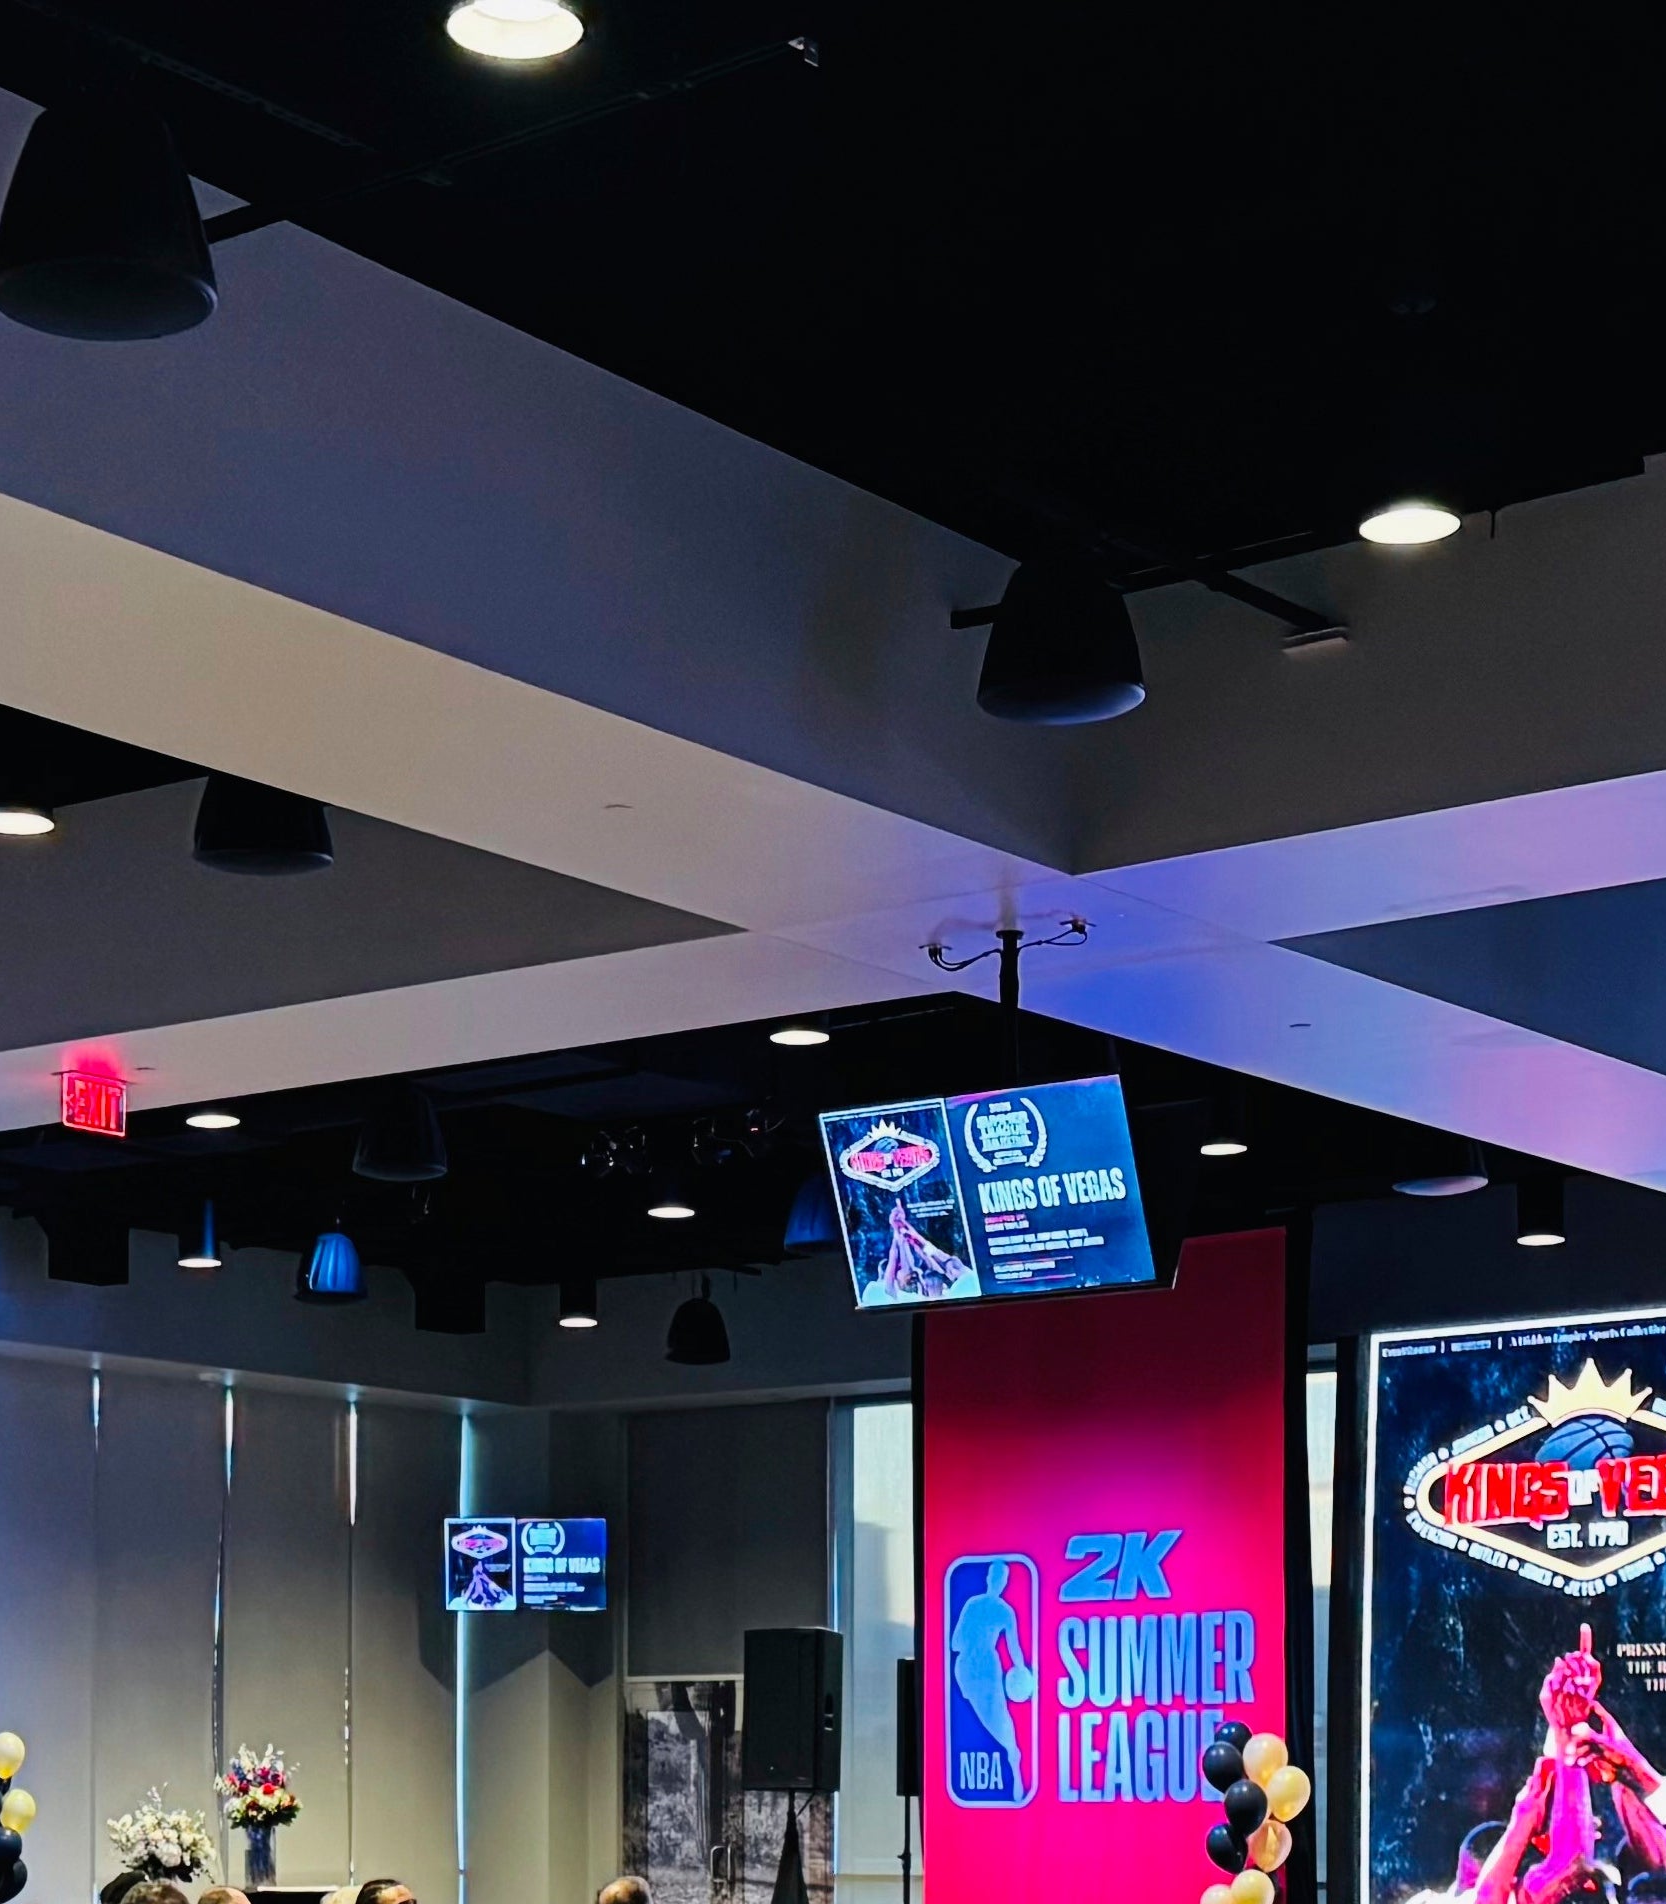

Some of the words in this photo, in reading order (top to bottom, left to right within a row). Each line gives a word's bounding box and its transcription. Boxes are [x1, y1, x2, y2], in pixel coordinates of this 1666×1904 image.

[75, 1079, 121, 1130] EXIT
[978, 1178, 1035, 1214] KINGS
[1037, 1174, 1062, 1208] OF
[1064, 1167, 1126, 1205] VEGAS
[1445, 1461, 1569, 1530] KINGS
[1546, 1523, 1584, 1549] EST.
[1058, 1530, 1182, 1601] 2K
[1057, 1610, 1254, 1707] SUMMER
[1626, 1660, 1653, 1674] THE
[959, 1751, 1004, 1791] NBA
